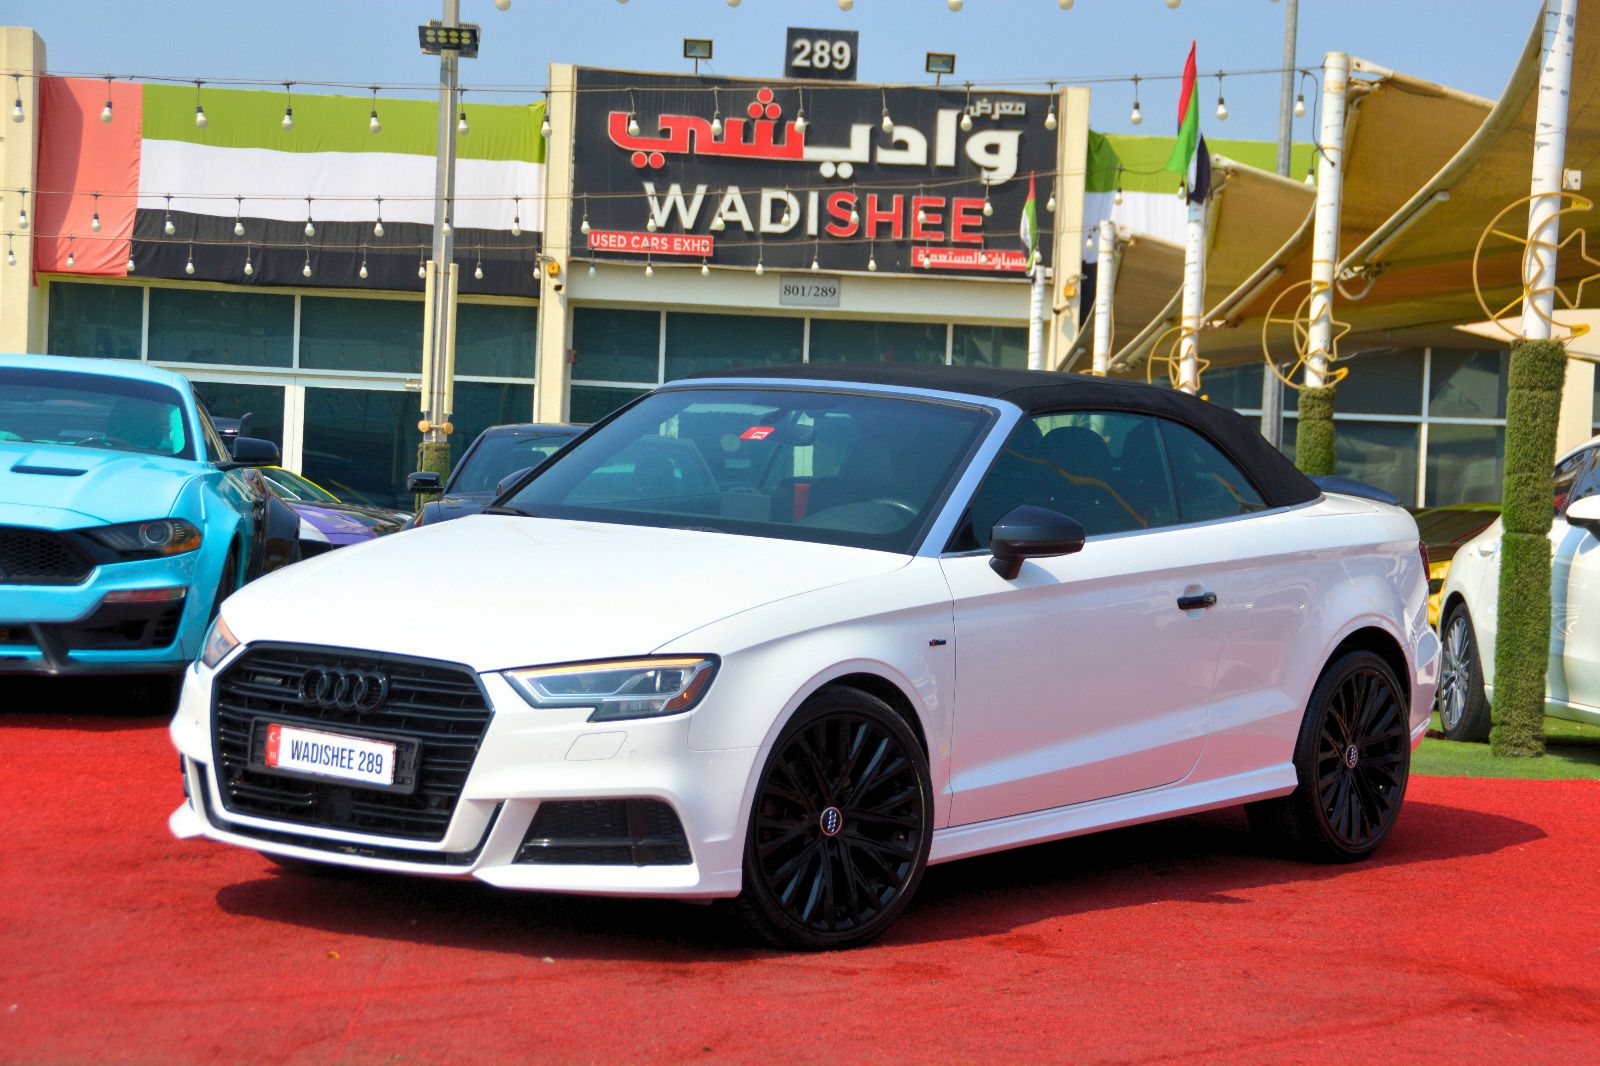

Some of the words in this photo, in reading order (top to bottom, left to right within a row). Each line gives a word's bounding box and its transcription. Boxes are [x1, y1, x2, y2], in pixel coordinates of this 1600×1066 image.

[792, 38, 851, 70] 289
[969, 98, 1026, 120] معرض
[608, 87, 1023, 186] واديشي
[643, 181, 985, 242] WADISHEE
[591, 233, 627, 248] USED
[631, 236, 669, 250] CARS
[917, 249, 982, 264] المستعمة
[783, 285, 837, 297] 801/289
[291, 739, 354, 770] WADISHEE
[358, 750, 384, 775] 289
